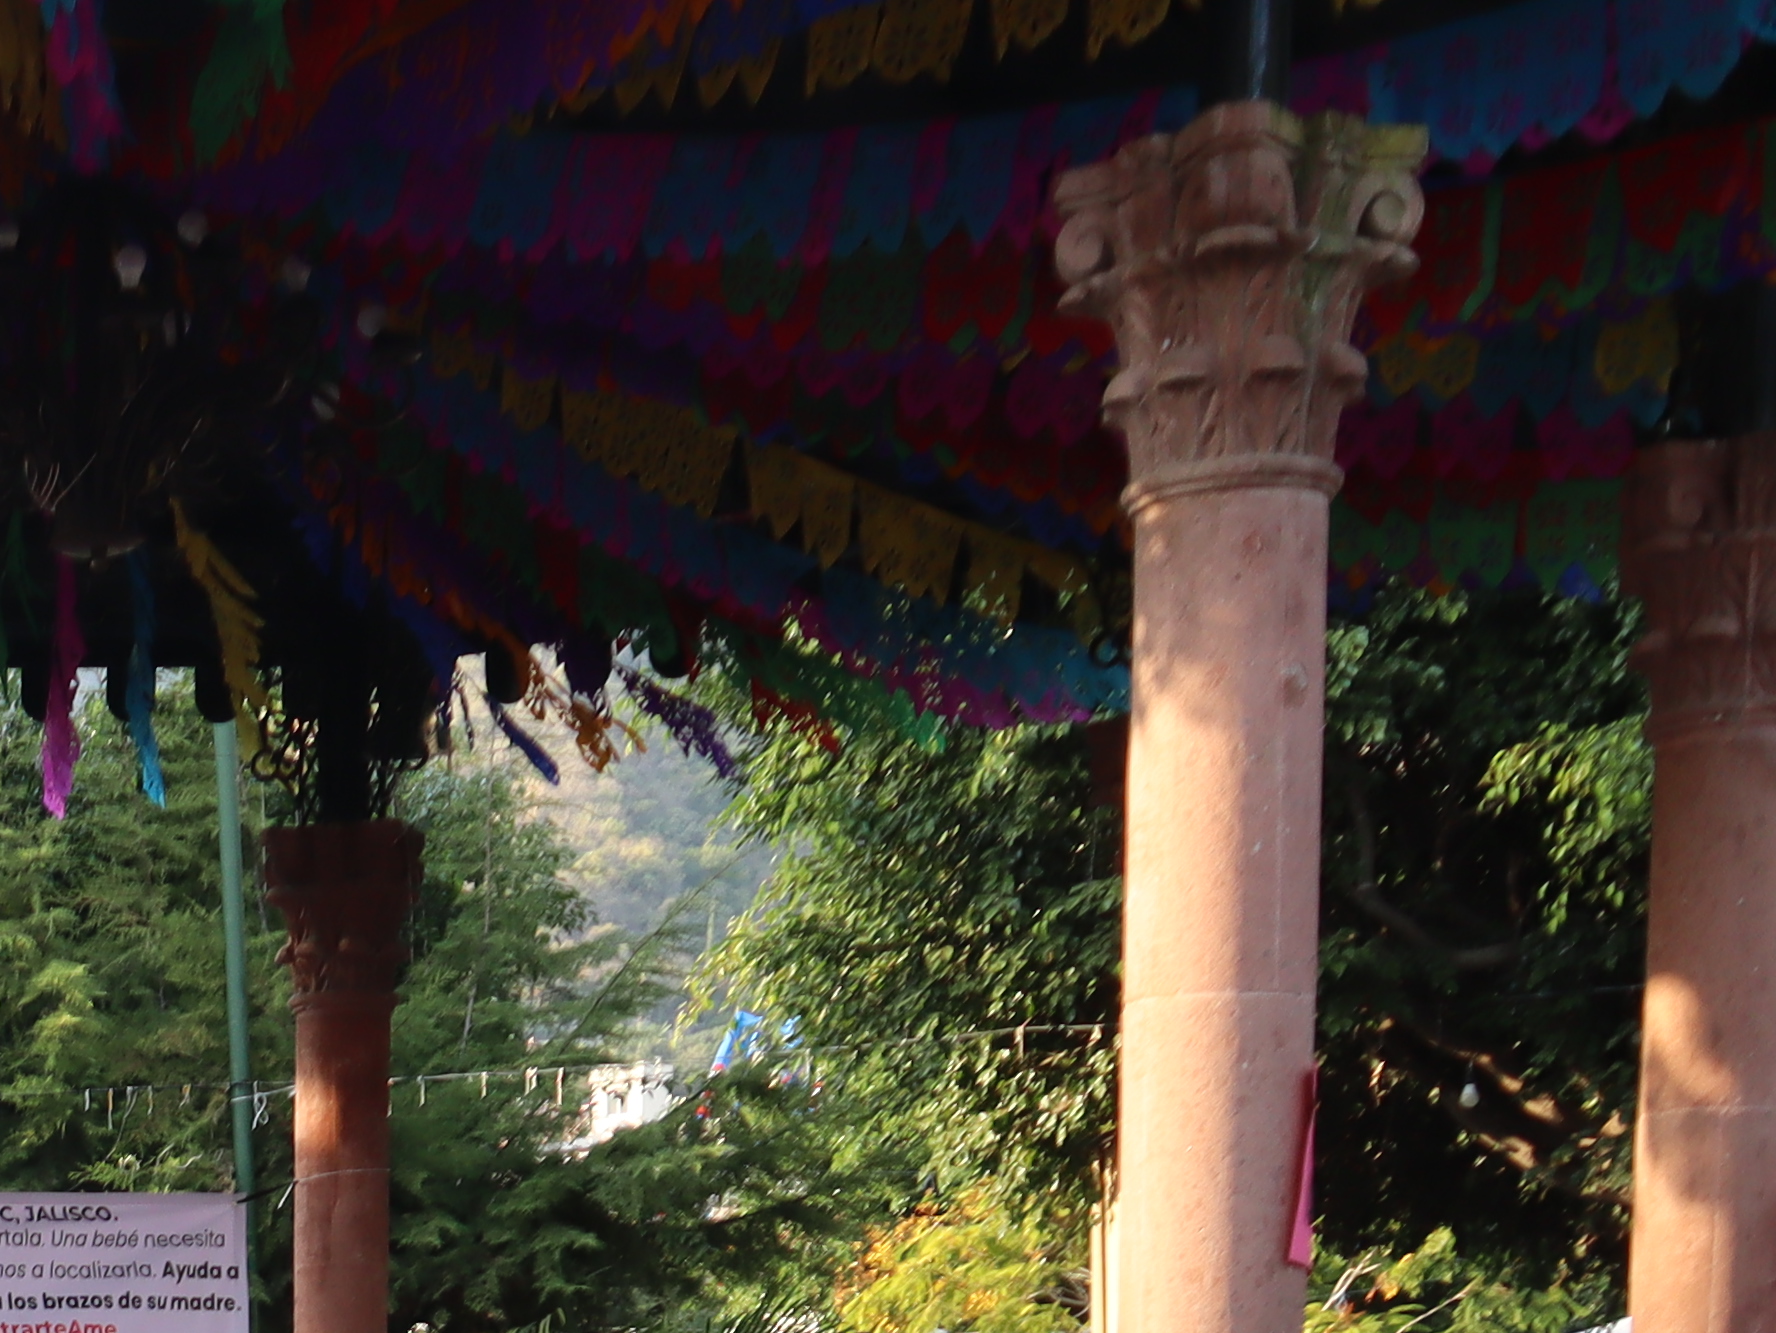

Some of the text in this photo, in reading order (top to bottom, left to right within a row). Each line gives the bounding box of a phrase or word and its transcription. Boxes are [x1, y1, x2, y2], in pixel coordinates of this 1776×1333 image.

[25, 1205, 119, 1223] JALISCO.
[52, 1229, 88, 1247] Una
[91, 1229, 139, 1248] bebé
[144, 1229, 226, 1248] necesita
[31, 1263, 44, 1279] a
[49, 1259, 157, 1279] localizarla.
[162, 1260, 222, 1284] Ayuda
[226, 1265, 240, 1280] a
[8, 1291, 38, 1310] los
[42, 1291, 114, 1311] brazos
[118, 1291, 143, 1311] de
[147, 1295, 169, 1311] su
[170, 1293, 242, 1312] madre.
